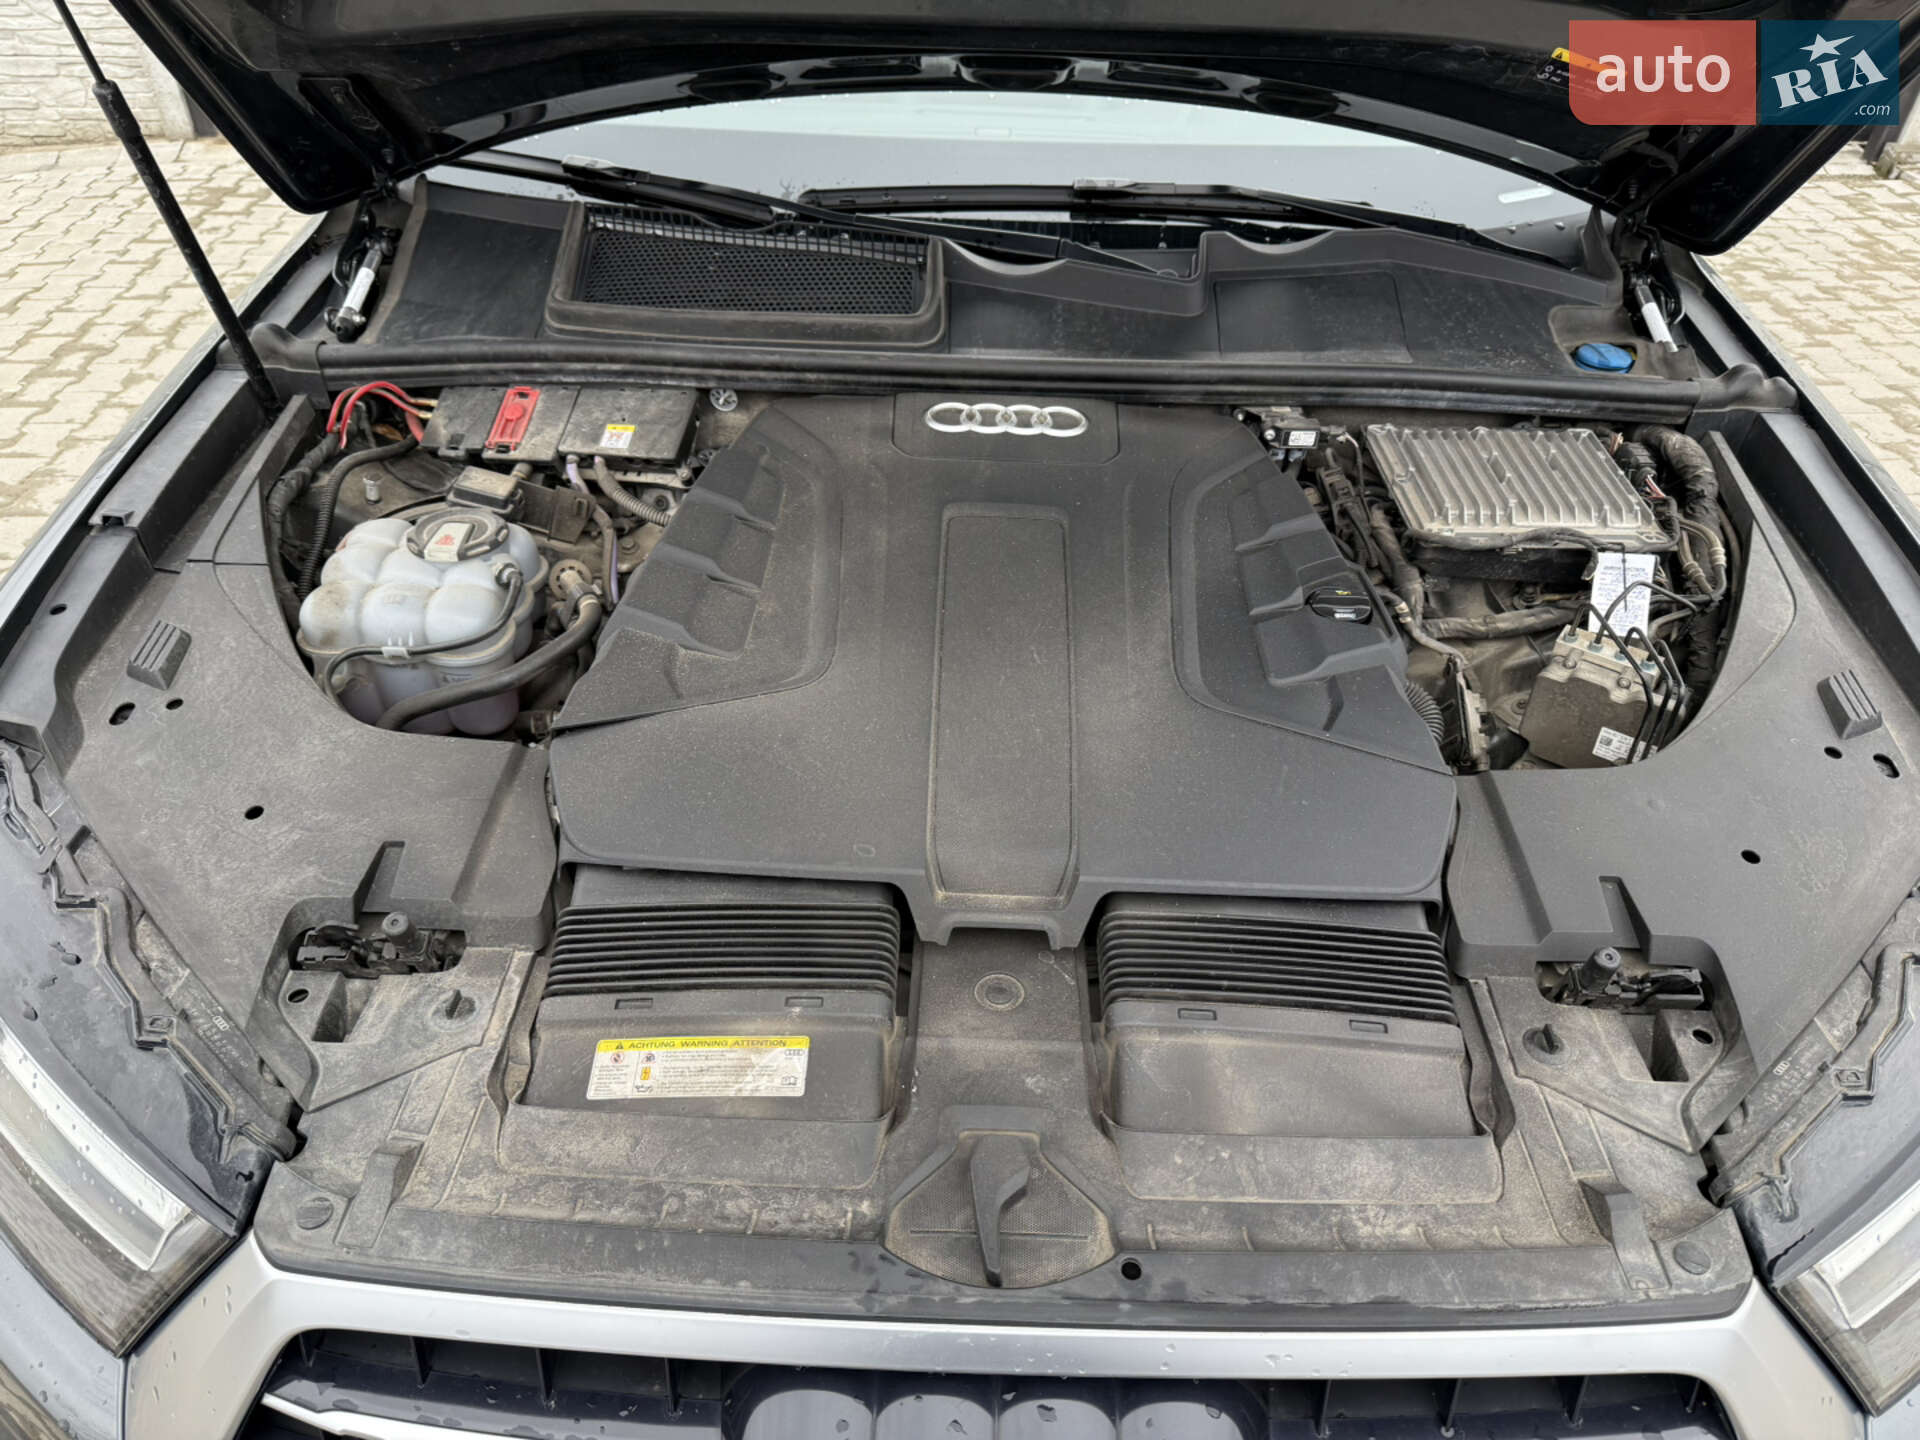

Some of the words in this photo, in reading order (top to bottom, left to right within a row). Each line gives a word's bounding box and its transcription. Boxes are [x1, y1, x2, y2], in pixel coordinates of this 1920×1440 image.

[628, 1040, 676, 1049] ACHTUNG
[680, 1040, 728, 1048] WARNING
[732, 1039, 787, 1048] ATTENTION
